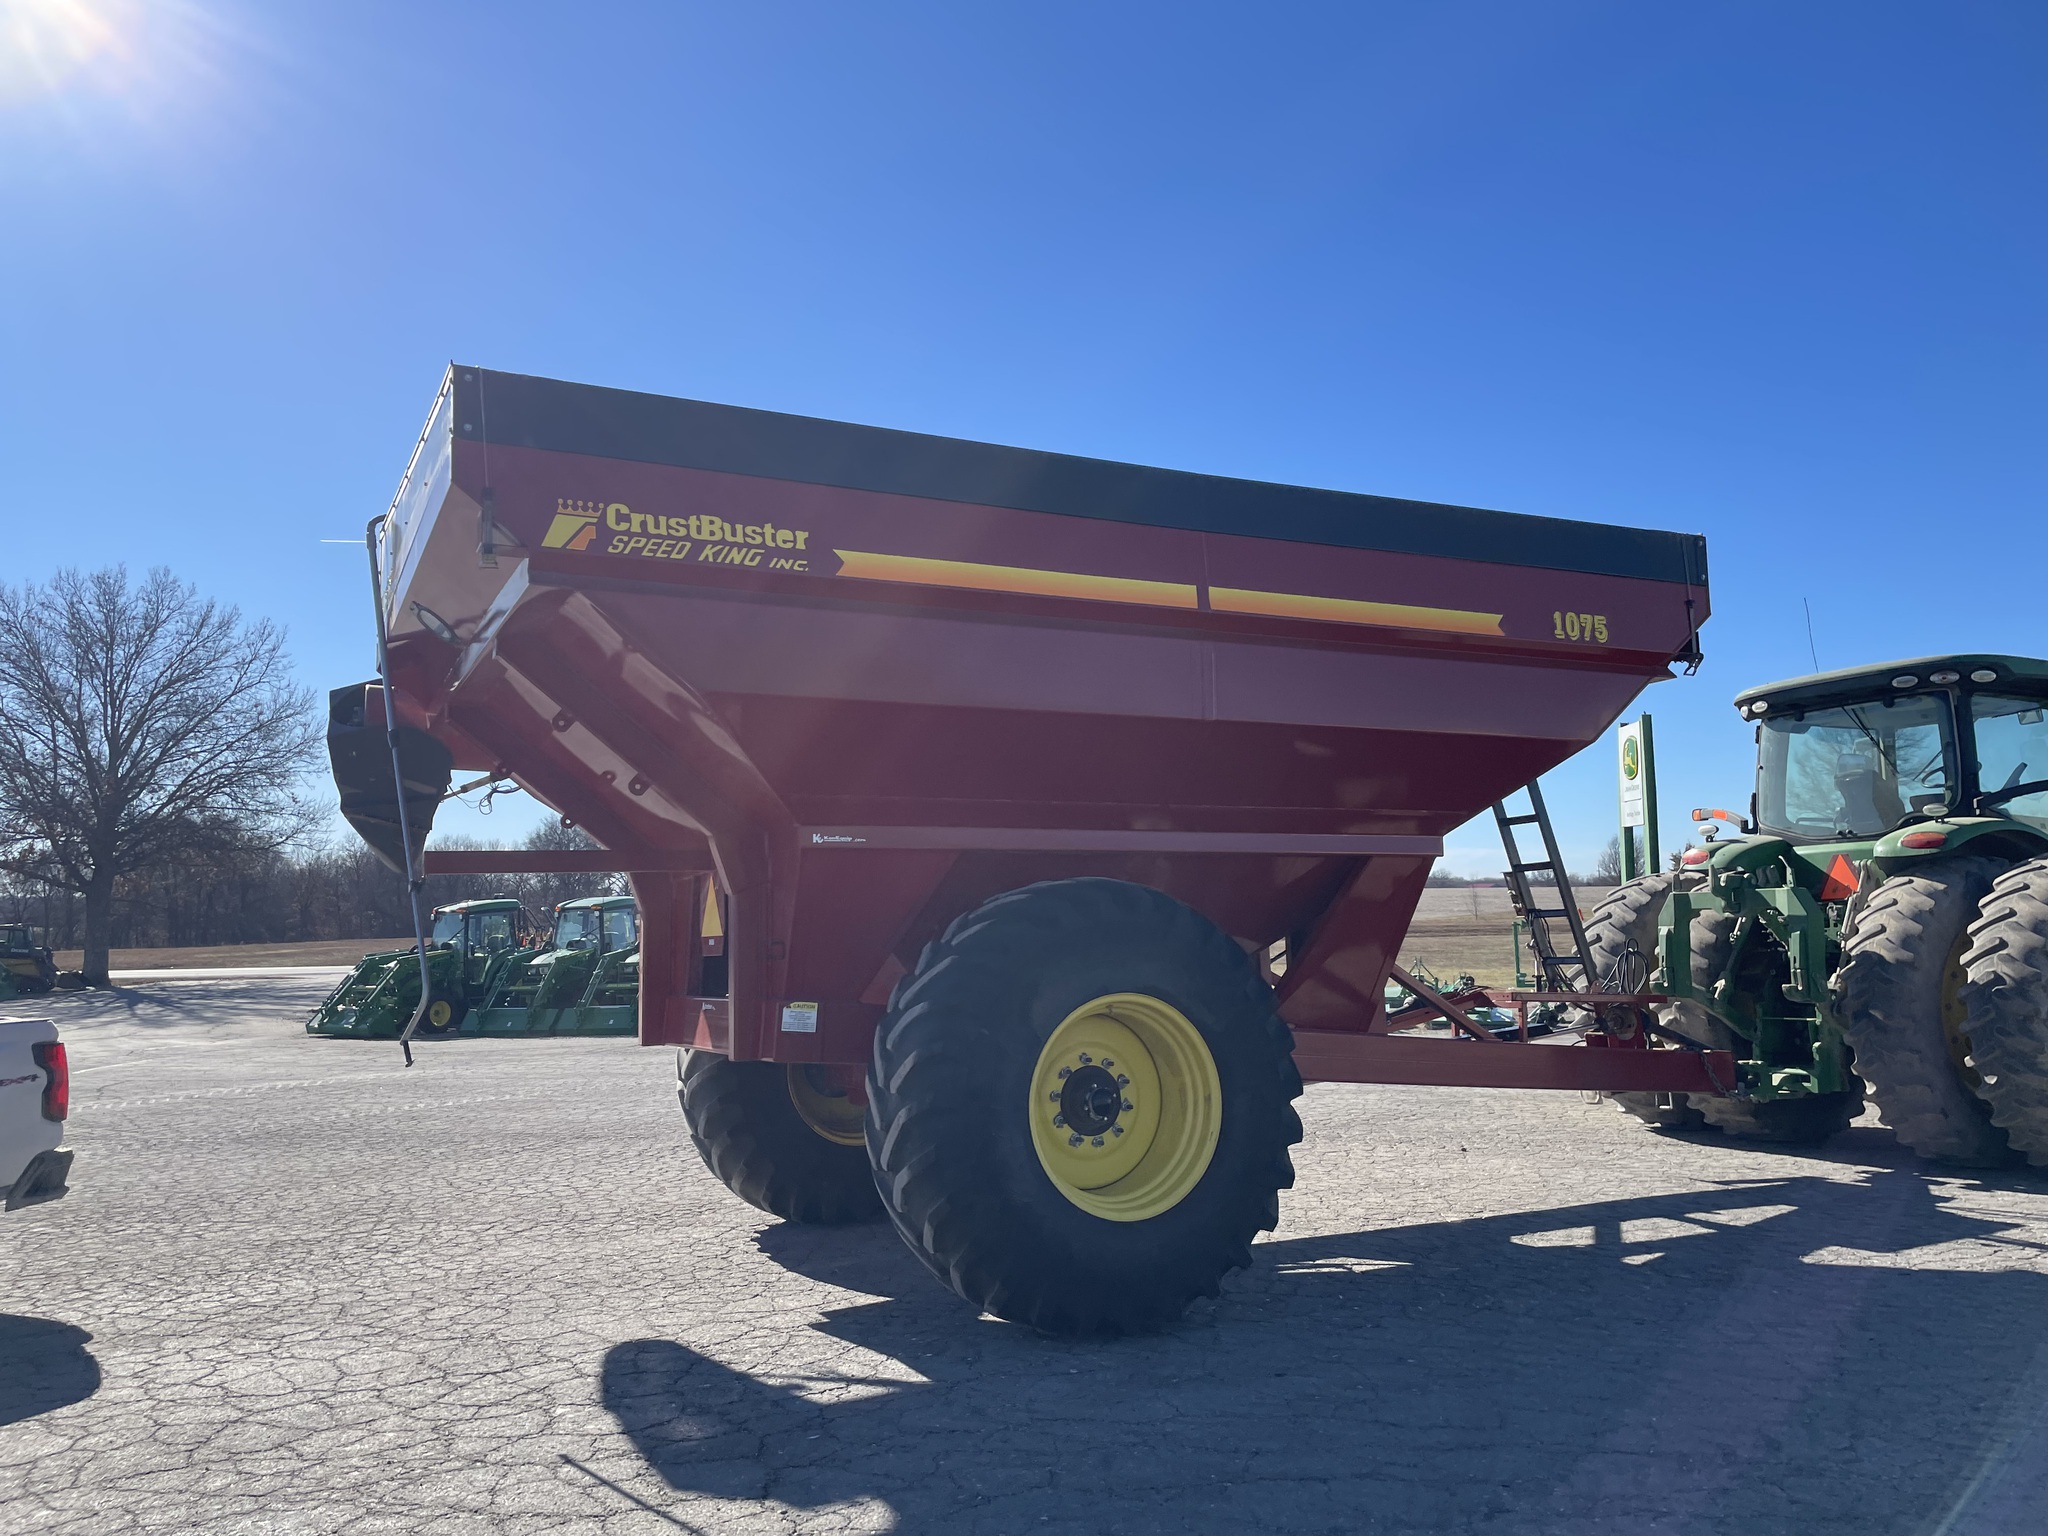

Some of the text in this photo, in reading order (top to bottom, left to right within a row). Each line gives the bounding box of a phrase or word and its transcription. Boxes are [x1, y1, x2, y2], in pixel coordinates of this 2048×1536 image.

[606, 502, 809, 550] CrustBuster
[607, 535, 809, 571] SPEED KING INC.
[1553, 611, 1608, 643] 1075
